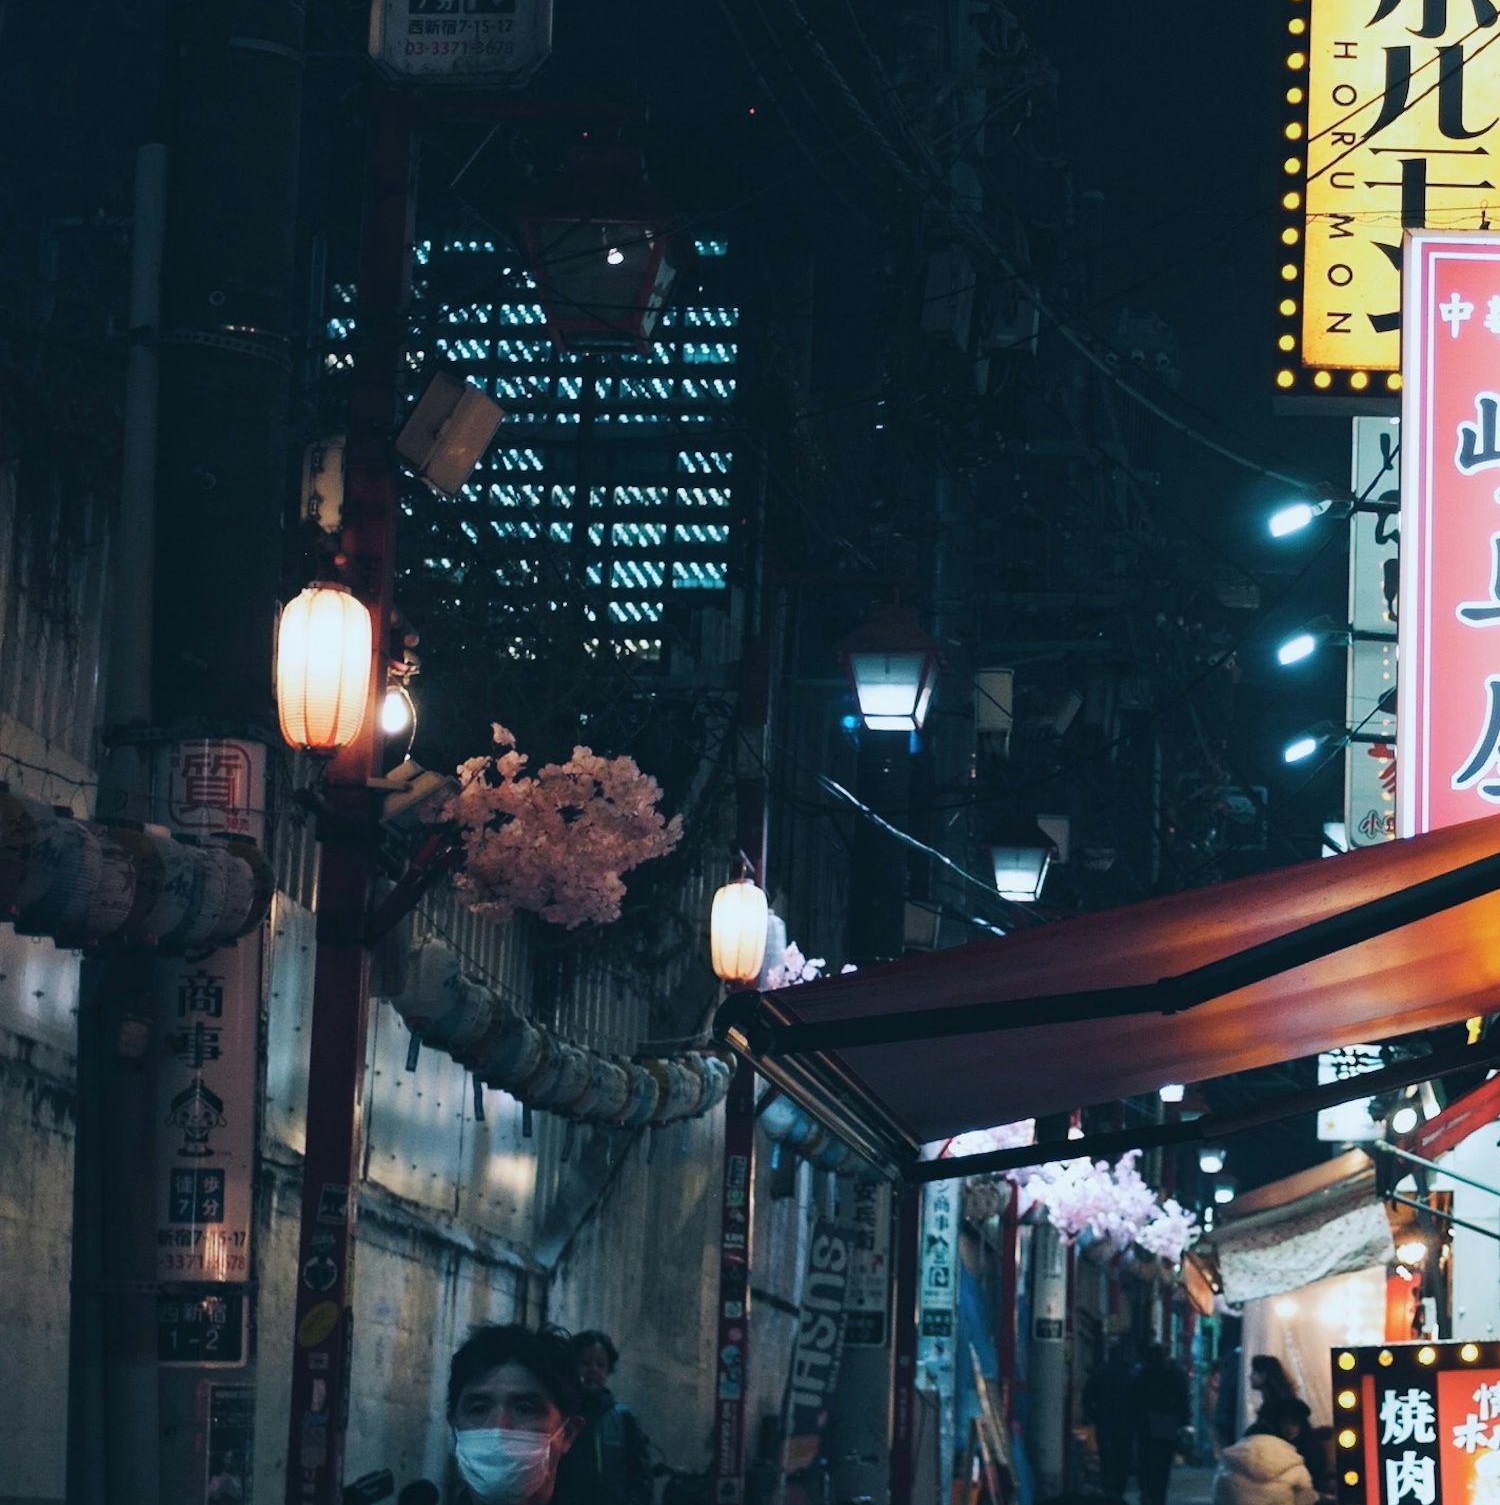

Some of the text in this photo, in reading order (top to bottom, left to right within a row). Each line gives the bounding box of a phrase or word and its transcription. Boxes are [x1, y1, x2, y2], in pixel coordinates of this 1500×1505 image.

[1326, 41, 1358, 334] HORUMON
[178, 754, 242, 815] 質
[175, 1175, 221, 1194] 徒歩
[177, 1198, 220, 1218] 7分
[169, 1328, 220, 1351] 1-2
[792, 1234, 847, 1408] SUSHI
